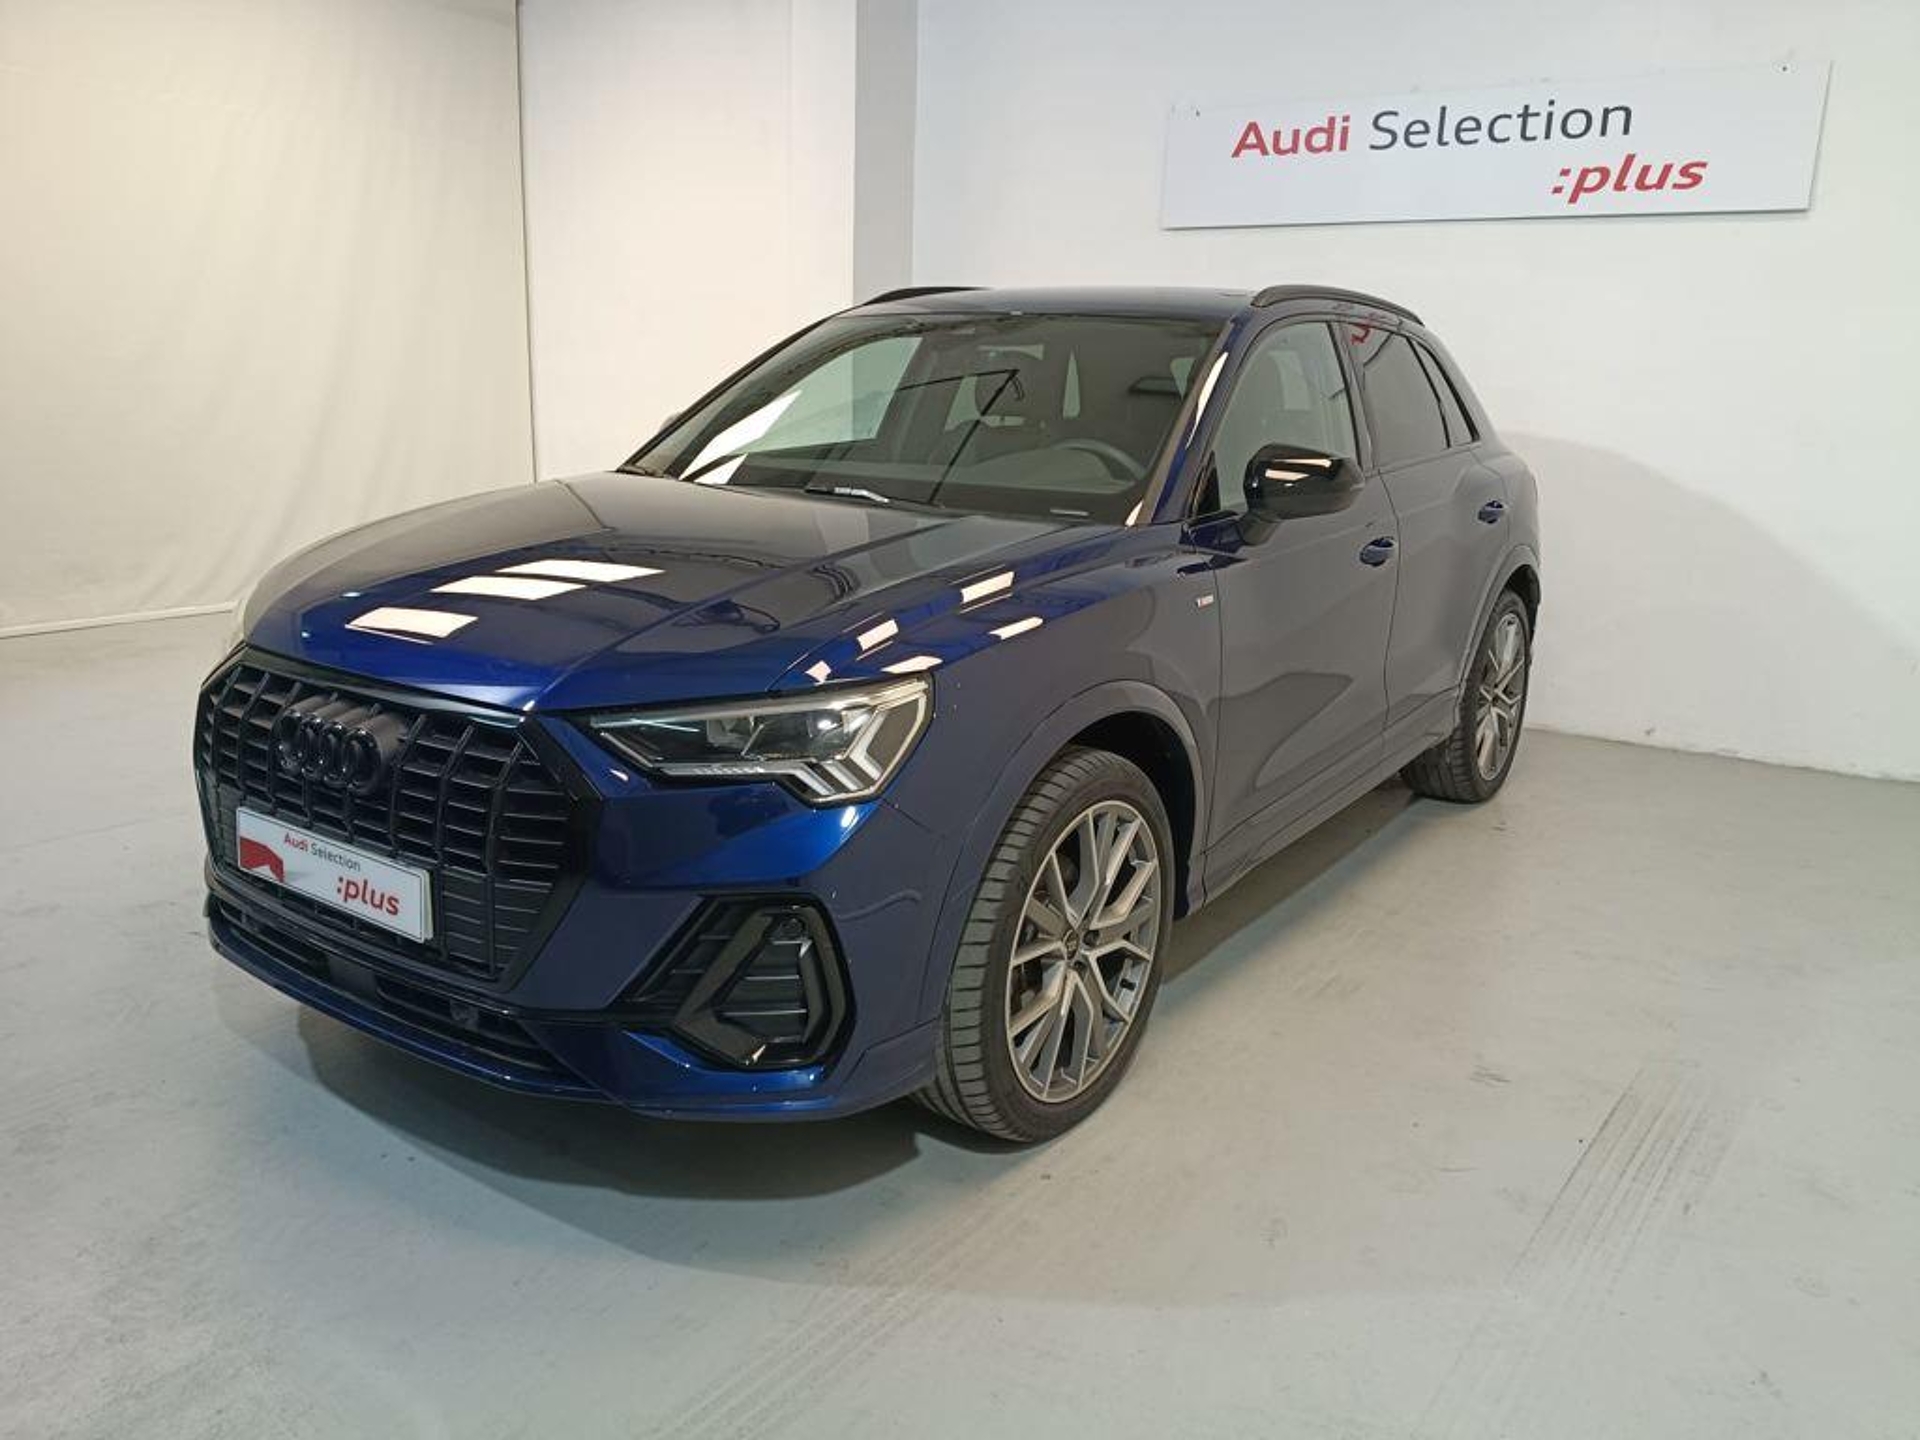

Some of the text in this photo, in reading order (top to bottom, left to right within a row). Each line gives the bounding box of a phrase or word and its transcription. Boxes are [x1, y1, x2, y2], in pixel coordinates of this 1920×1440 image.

[1231, 99, 1632, 158] Audi Selection
[1551, 153, 1708, 204] :plus
[284, 833, 361, 872] Audi Selection
[337, 876, 400, 916] :plus
